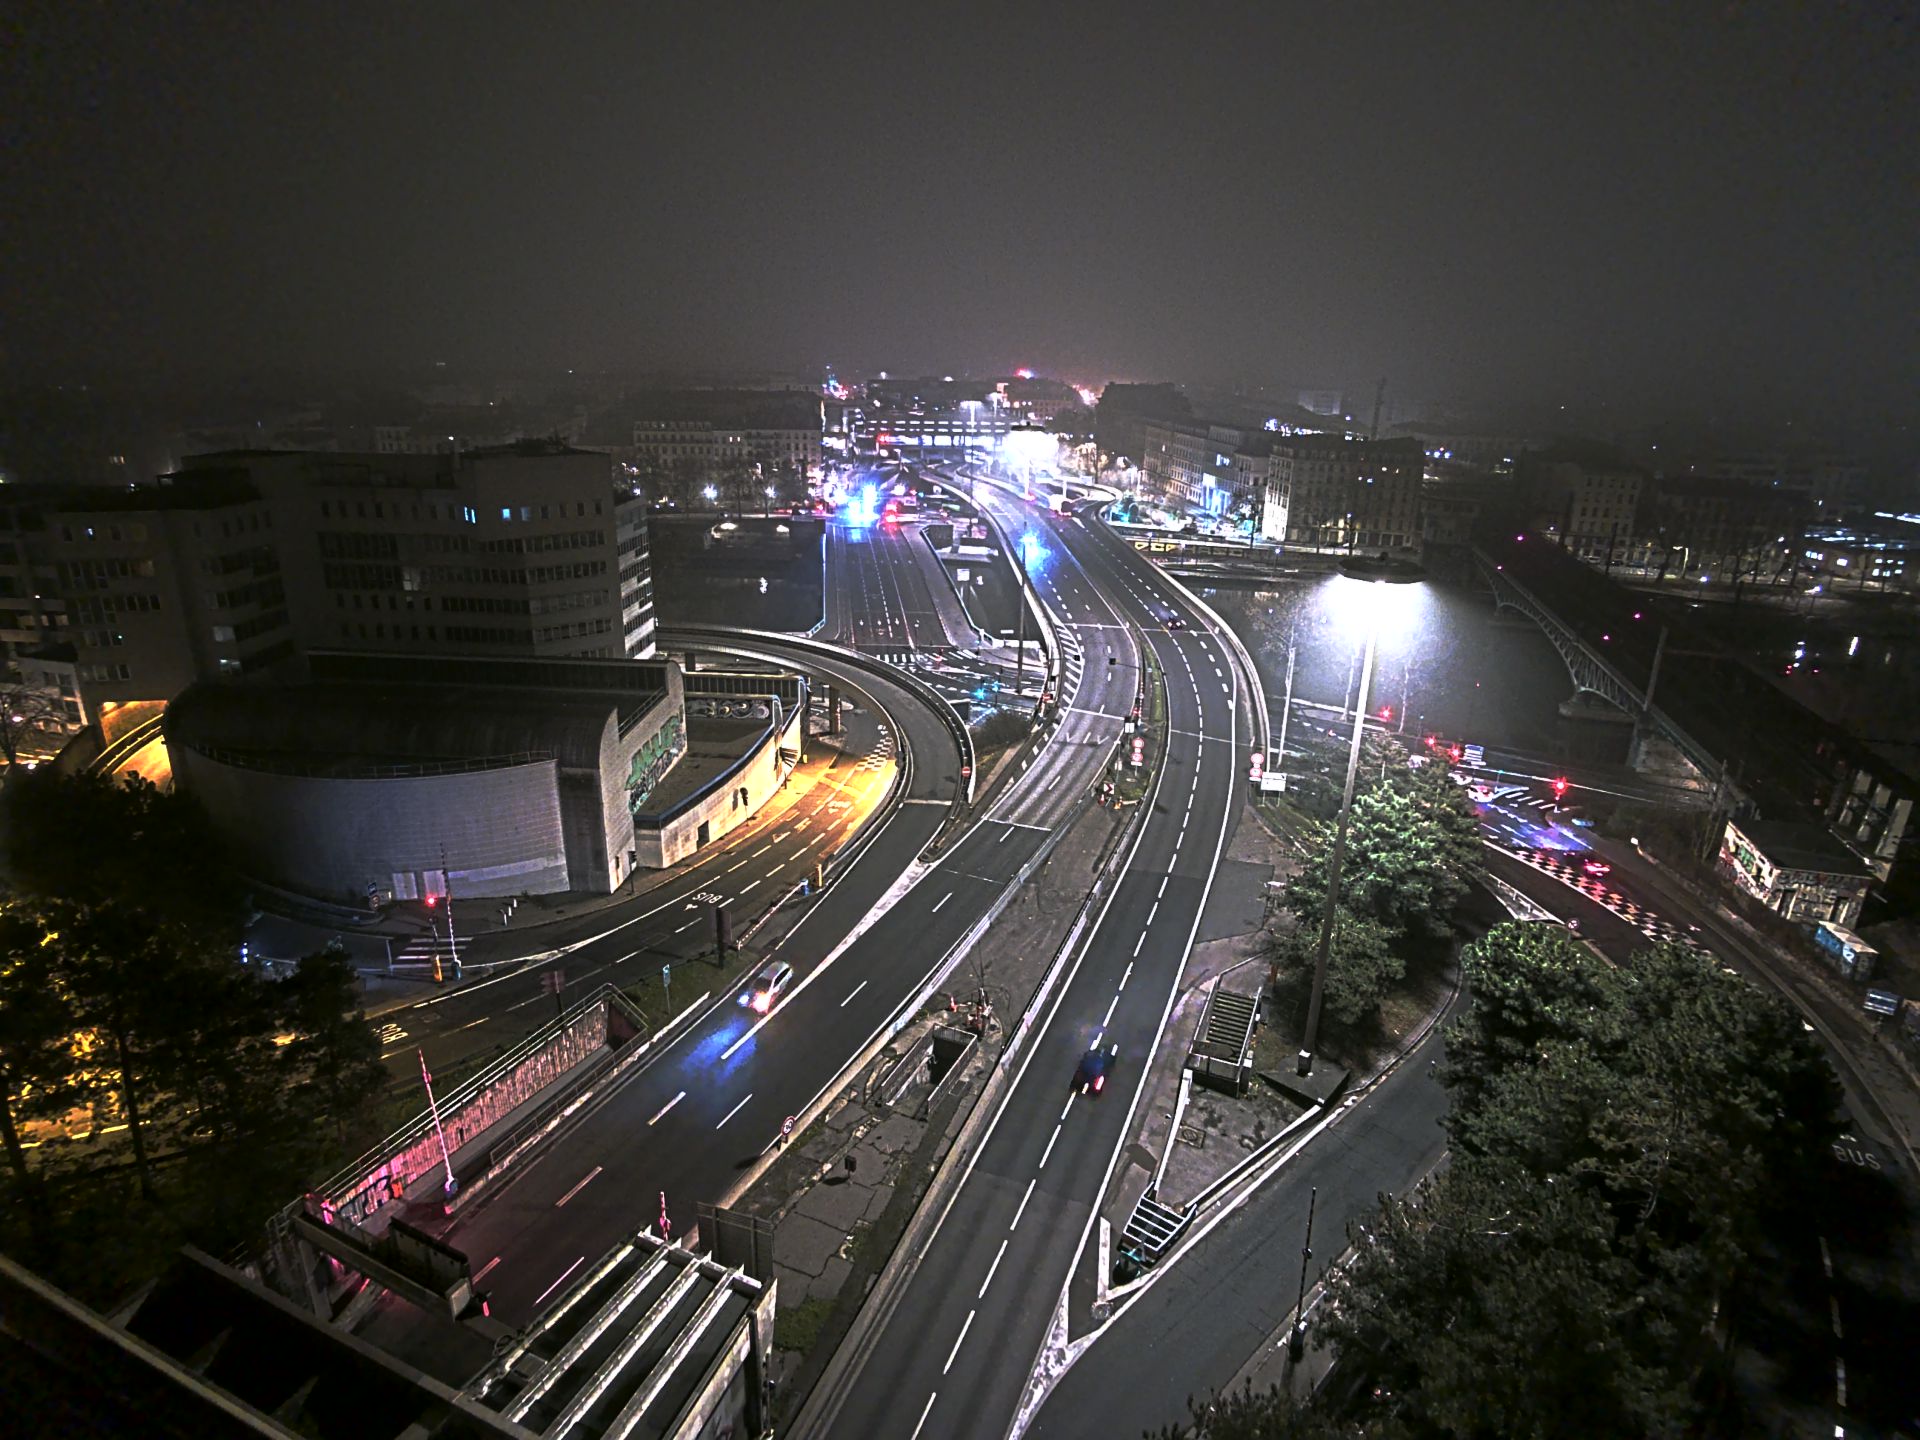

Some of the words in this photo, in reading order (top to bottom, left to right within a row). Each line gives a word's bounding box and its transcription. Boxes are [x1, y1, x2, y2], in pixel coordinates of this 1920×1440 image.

[692, 892, 723, 904] BUS
[381, 1023, 409, 1045] BUS
[1831, 1144, 1881, 1171] BUS
